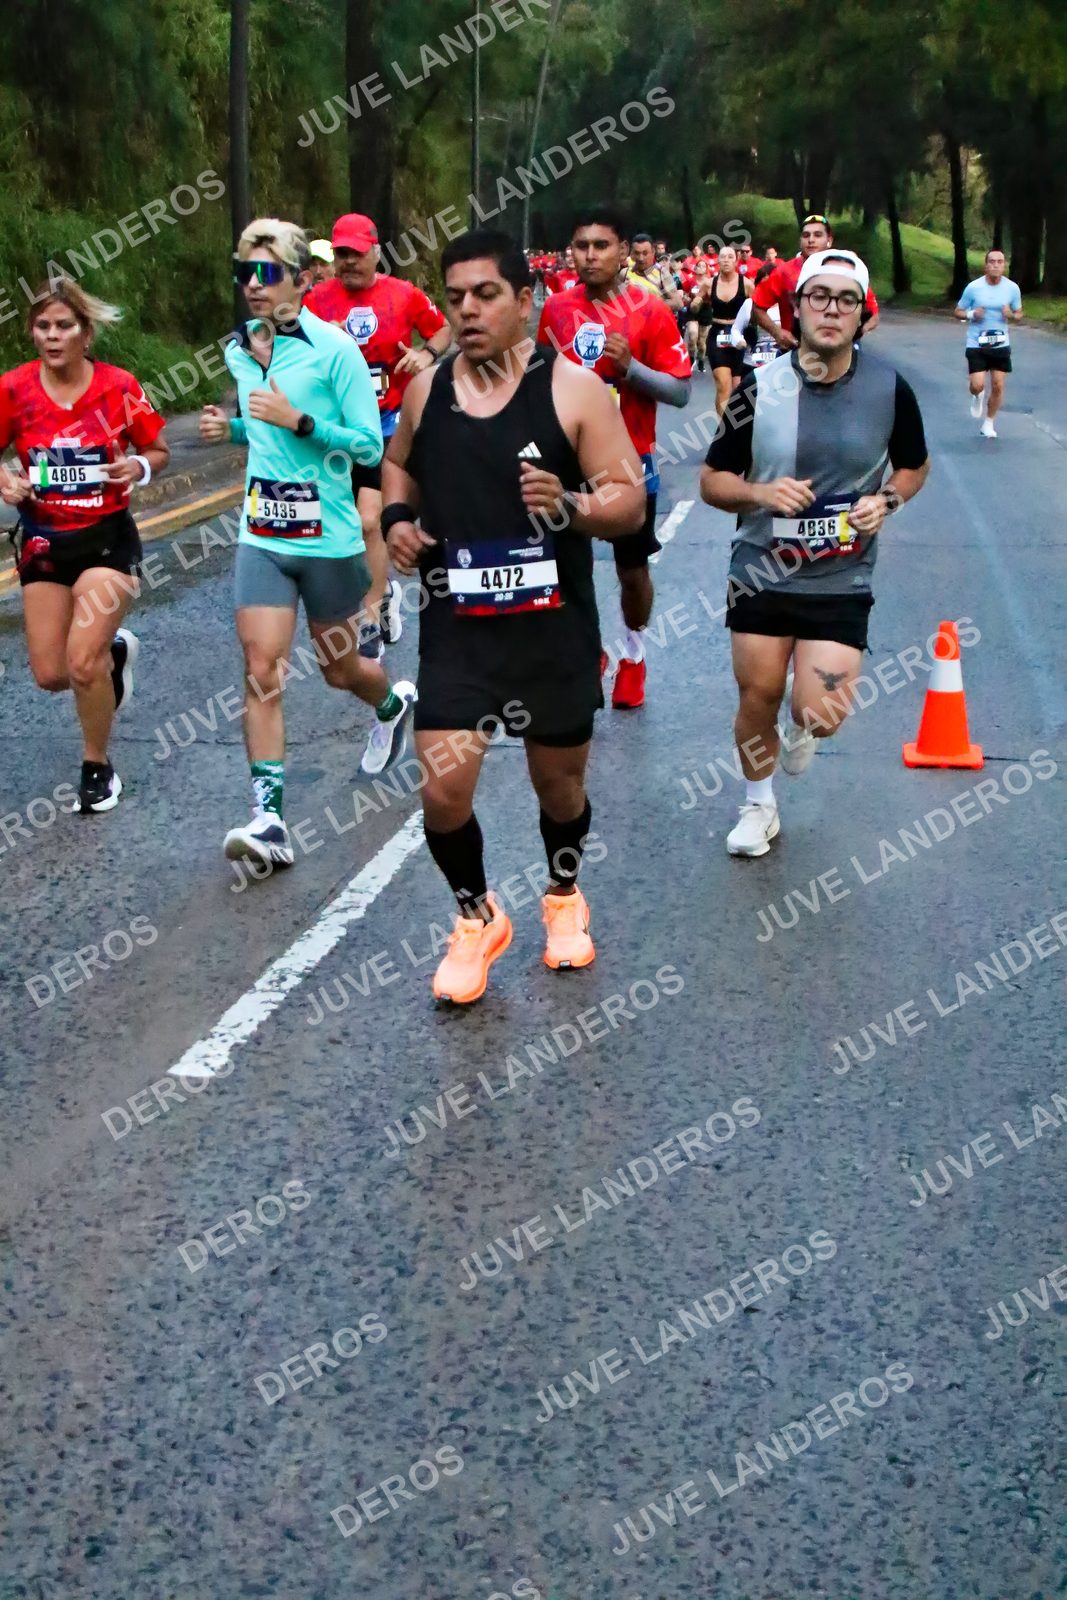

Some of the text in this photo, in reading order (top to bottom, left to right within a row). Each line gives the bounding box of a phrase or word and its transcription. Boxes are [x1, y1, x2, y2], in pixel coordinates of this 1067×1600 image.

[51, 467, 86, 483] 4805
[264, 501, 297, 519] 5435
[797, 519, 836, 537] 4836
[480, 566, 525, 590] 4472
